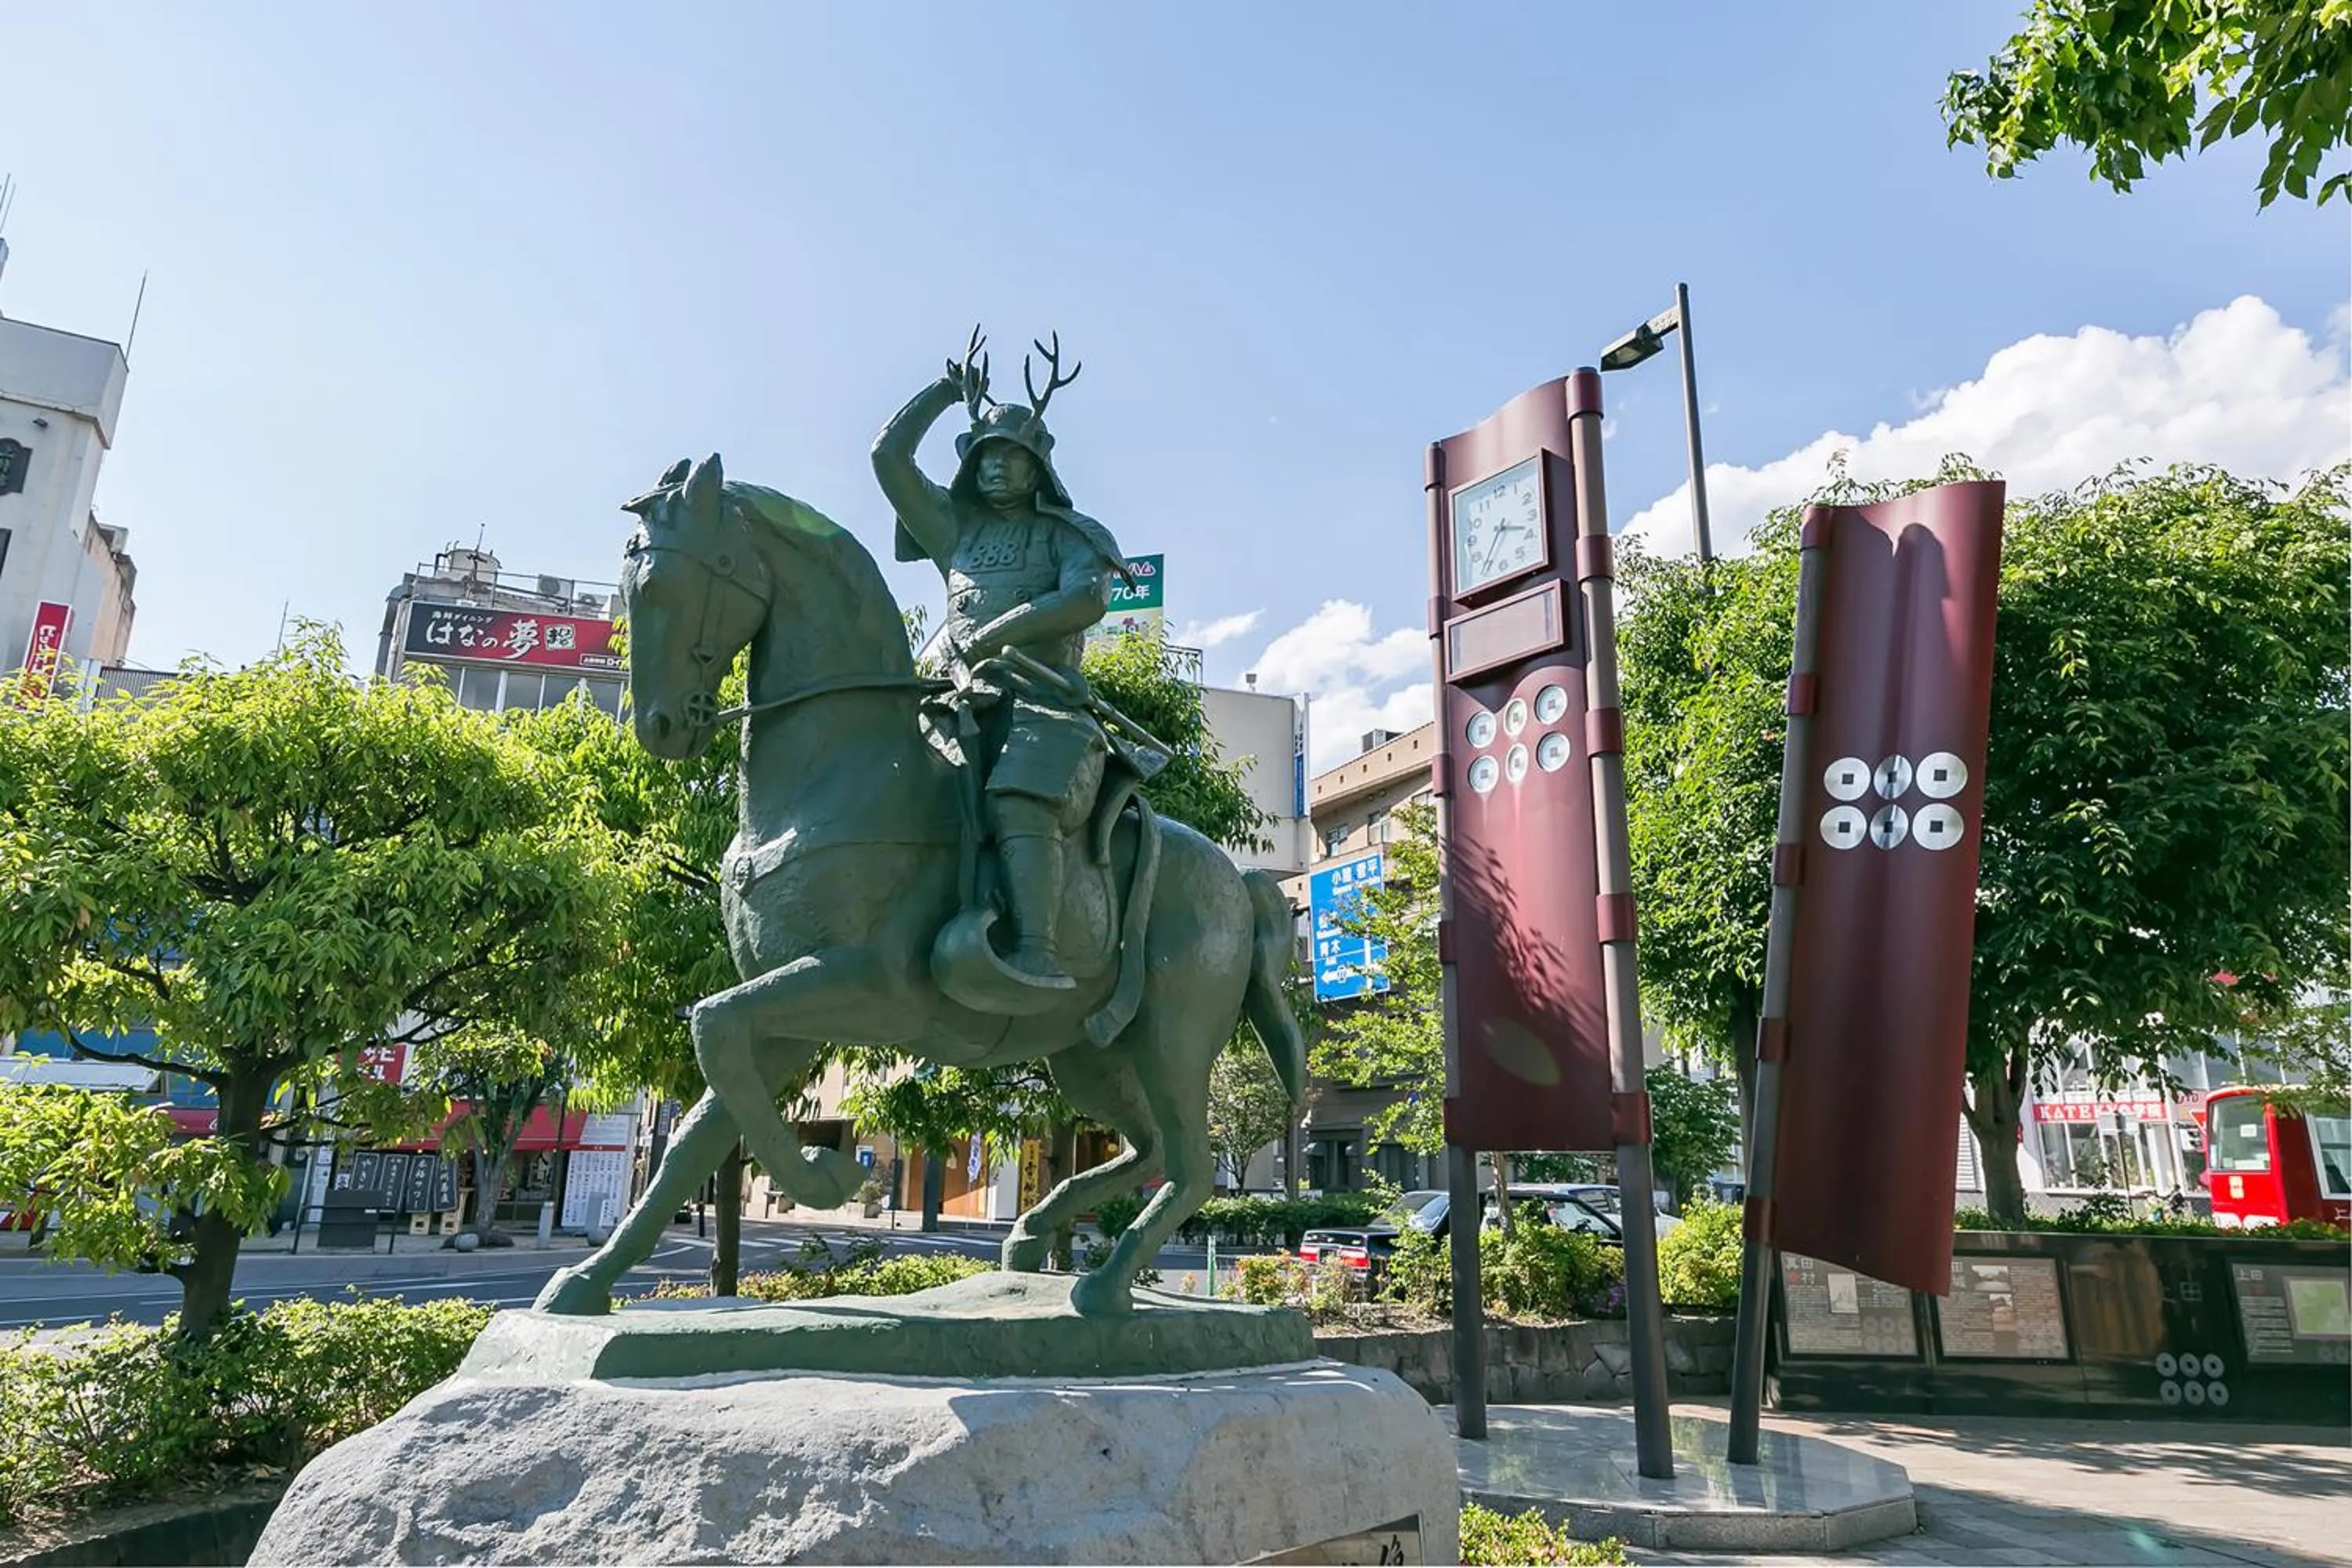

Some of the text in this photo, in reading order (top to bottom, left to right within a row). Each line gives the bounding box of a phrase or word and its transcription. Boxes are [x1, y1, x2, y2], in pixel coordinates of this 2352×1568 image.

[1494, 484, 1506, 499] 12
[1523, 492, 1533, 506] 2
[426, 619, 541, 659] はなの夢
